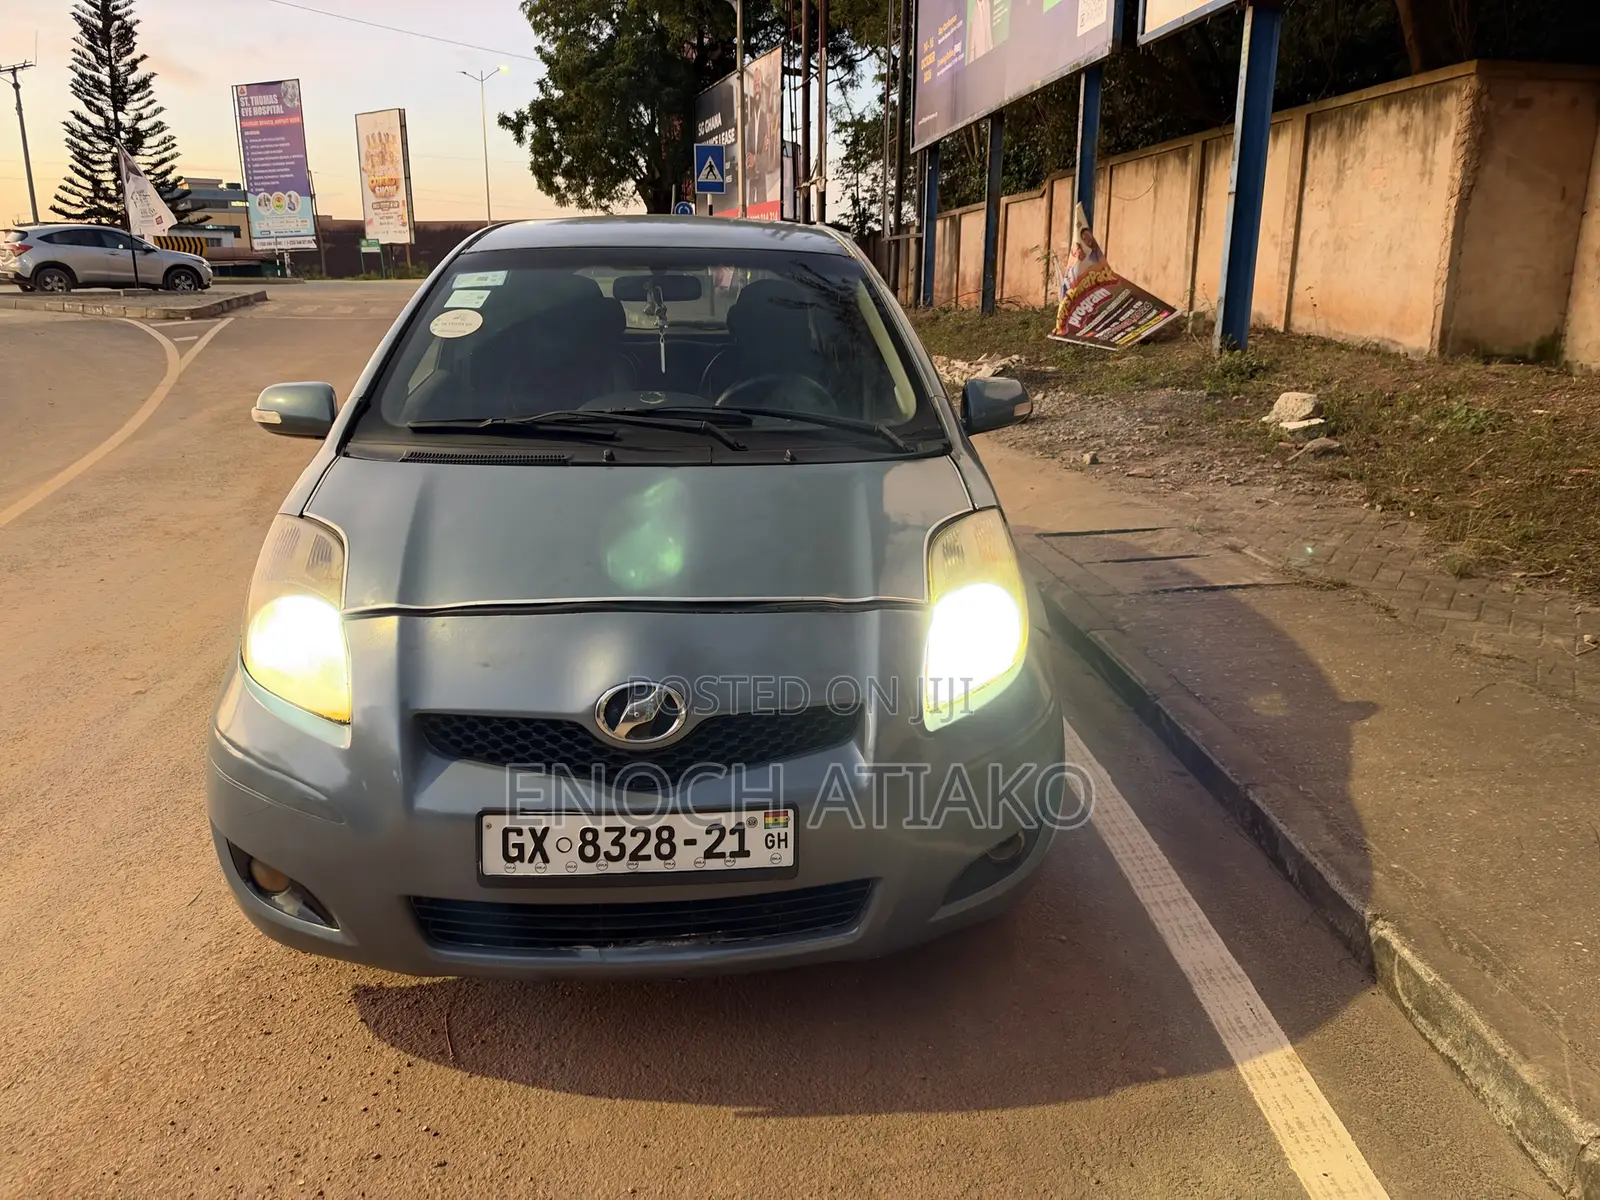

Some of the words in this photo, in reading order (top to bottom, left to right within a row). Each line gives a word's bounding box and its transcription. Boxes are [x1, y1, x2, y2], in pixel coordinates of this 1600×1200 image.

[240, 97, 250, 107] ST.
[250, 94, 279, 106] THOMAS
[241, 107, 252, 117] EYE
[253, 104, 284, 116] HOSPITAL
[698, 120, 705, 137] SG
[704, 112, 722, 133] GHANA
[1068, 287, 1111, 328] program
[501, 825, 550, 864] GX
[578, 821, 751, 863] 8328-21
[764, 831, 788, 850] GH
